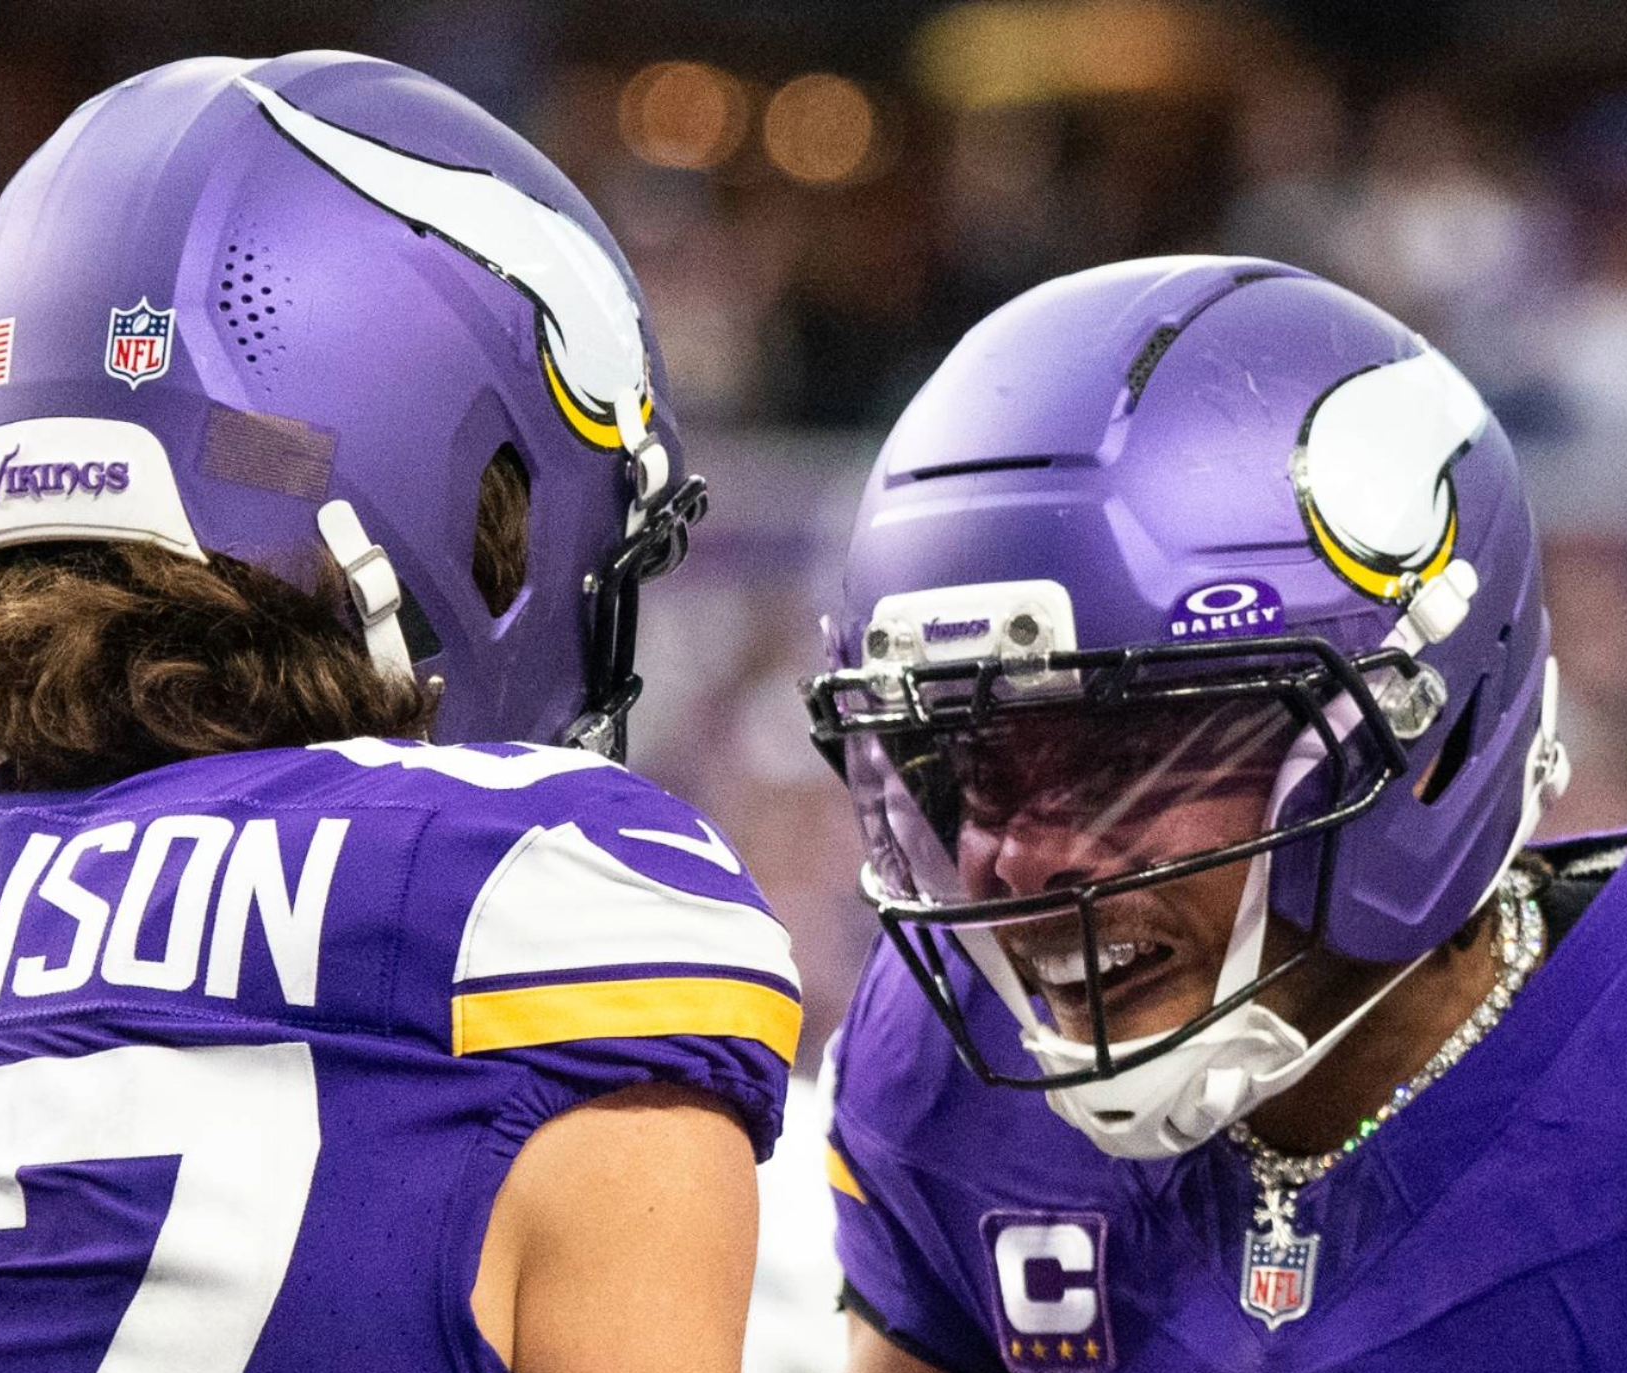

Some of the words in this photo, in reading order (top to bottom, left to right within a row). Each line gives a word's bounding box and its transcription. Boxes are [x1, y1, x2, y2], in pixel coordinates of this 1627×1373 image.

[114, 338, 160, 373] NFL
[1171, 607, 1277, 635] OAKLEY
[995, 1224, 1096, 1335] C
[1253, 1270, 1300, 1309] NFL
